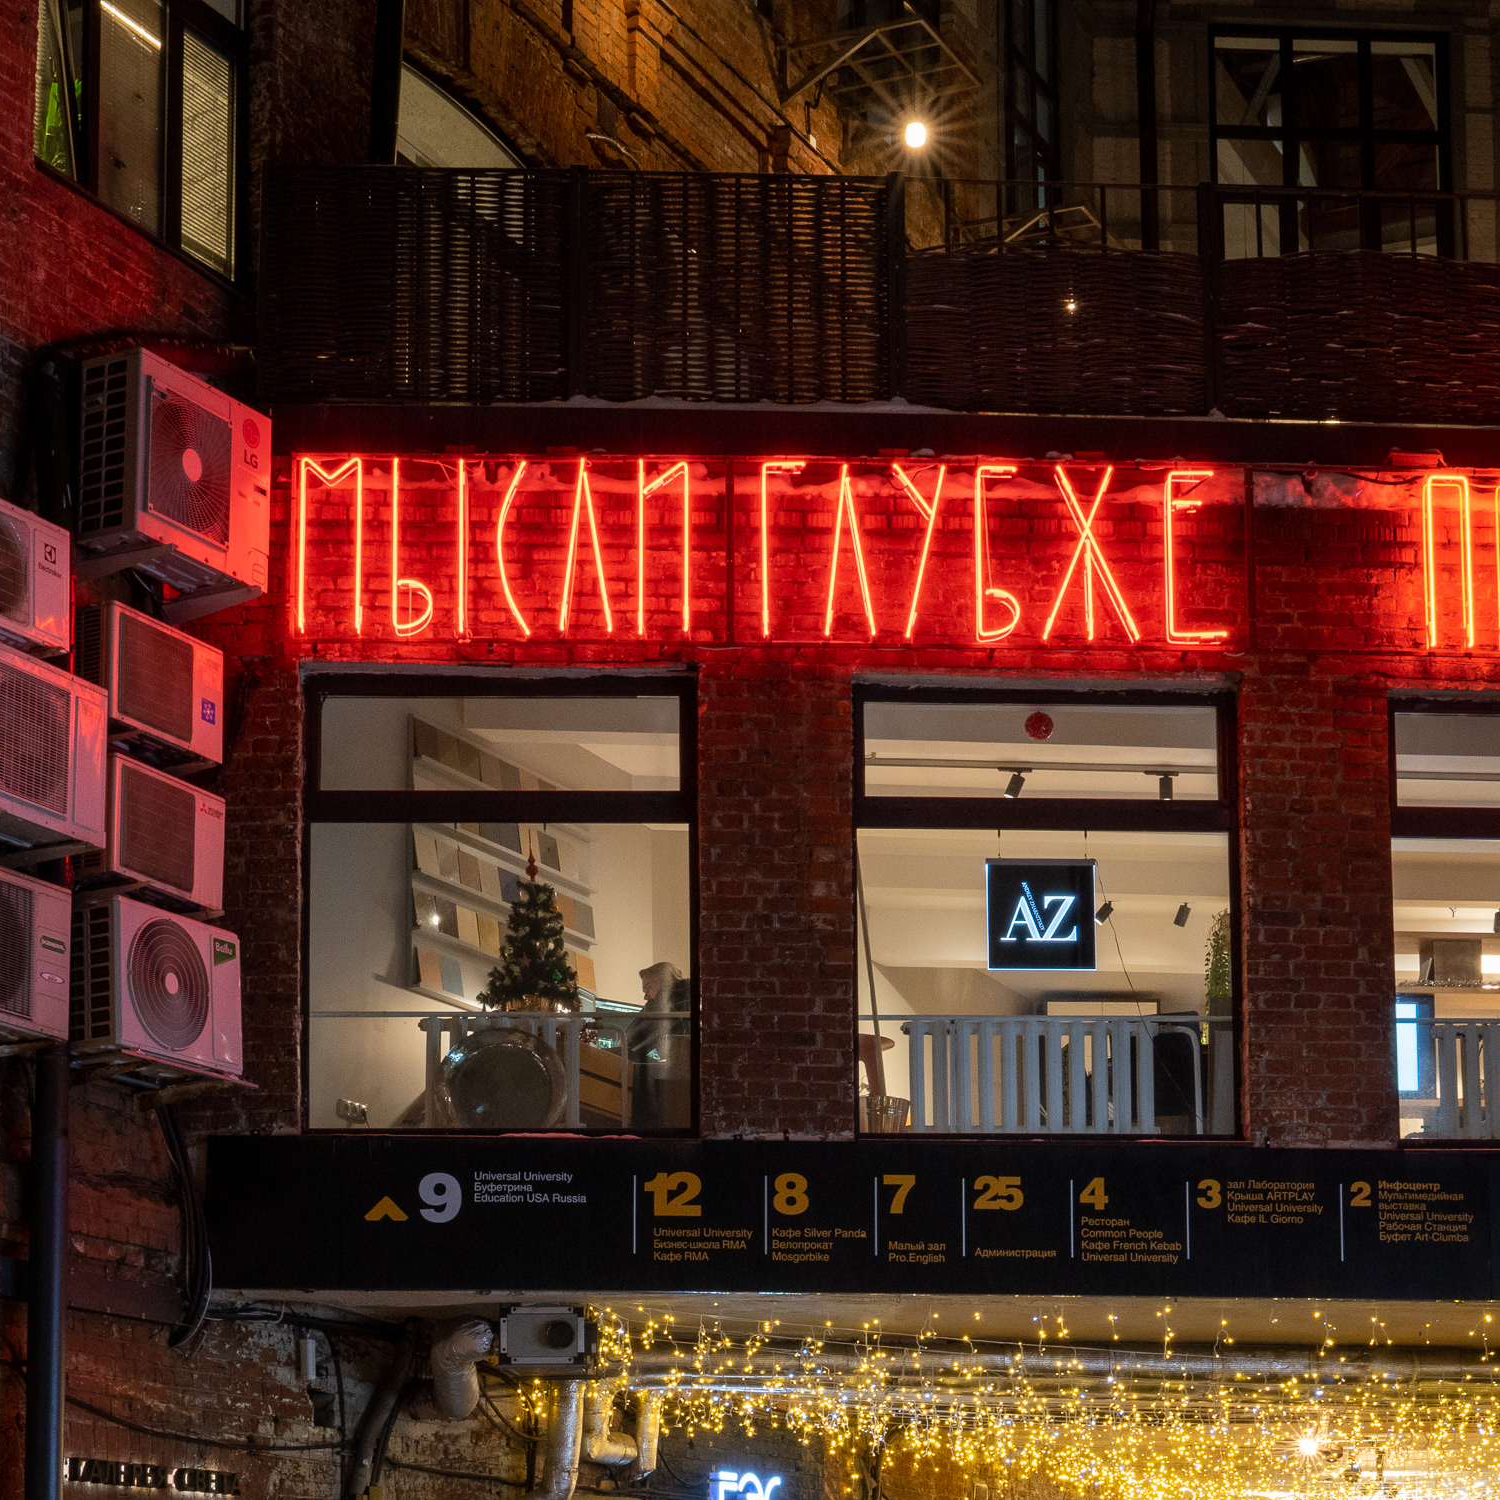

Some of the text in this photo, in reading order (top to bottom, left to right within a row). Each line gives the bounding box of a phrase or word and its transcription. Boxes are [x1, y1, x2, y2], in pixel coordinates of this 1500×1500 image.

[243, 449, 258, 469] LG
[761, 461, 1229, 644] ГЛУБЖЕ
[1000, 895, 1077, 942] AZ
[474, 1171, 573, 1183] Universal University
[474, 1182, 533, 1193] Буфетрина
[1227, 1180, 1315, 1191] зал Лаборатория
[1378, 1180, 1441, 1192] Инфоцентр
[418, 1172, 462, 1223] 9
[474, 1193, 587, 1203] Education USA Russia
[644, 1171, 702, 1216] 12
[773, 1172, 810, 1216] 8
[883, 1174, 916, 1214] 7
[973, 1175, 1024, 1211] 25
[1079, 1177, 1109, 1210] 4
[1197, 1179, 1222, 1209] 3
[1227, 1191, 1315, 1201] Крыша ARTPLAY
[1350, 1181, 1372, 1207] 2
[1378, 1190, 1464, 1201] Мультимедийная
[1227, 1202, 1323, 1215] Universal University
[1378, 1202, 1426, 1211] выставка
[1081, 1216, 1130, 1227] Ресторан
[1227, 1213, 1256, 1225] Кафе
[1270, 1214, 1304, 1224] Giorno
[1379, 1211, 1474, 1223] Universal University
[1379, 1221, 1467, 1232] Рабочая Станция
[653, 1227, 753, 1240] Universal University
[772, 1228, 867, 1239] Кафе Silver Panda
[1081, 1228, 1164, 1240] Common People
[1379, 1231, 1469, 1242] Буфет Art-Clumba
[653, 1239, 747, 1249] Бизнес-школа RMA
[772, 1240, 833, 1251] Велопрокат
[888, 1240, 946, 1251] Малый зал
[1081, 1240, 1182, 1251] Кафе French Kebab
[653, 1251, 709, 1262] Кафе RMA
[772, 1251, 830, 1263] Mosgorbike
[888, 1253, 946, 1265] Pro.English
[974, 1247, 1057, 1259] Администрация
[1081, 1252, 1179, 1264] Universal University
[173, 1467, 241, 1496] СВЕТА
